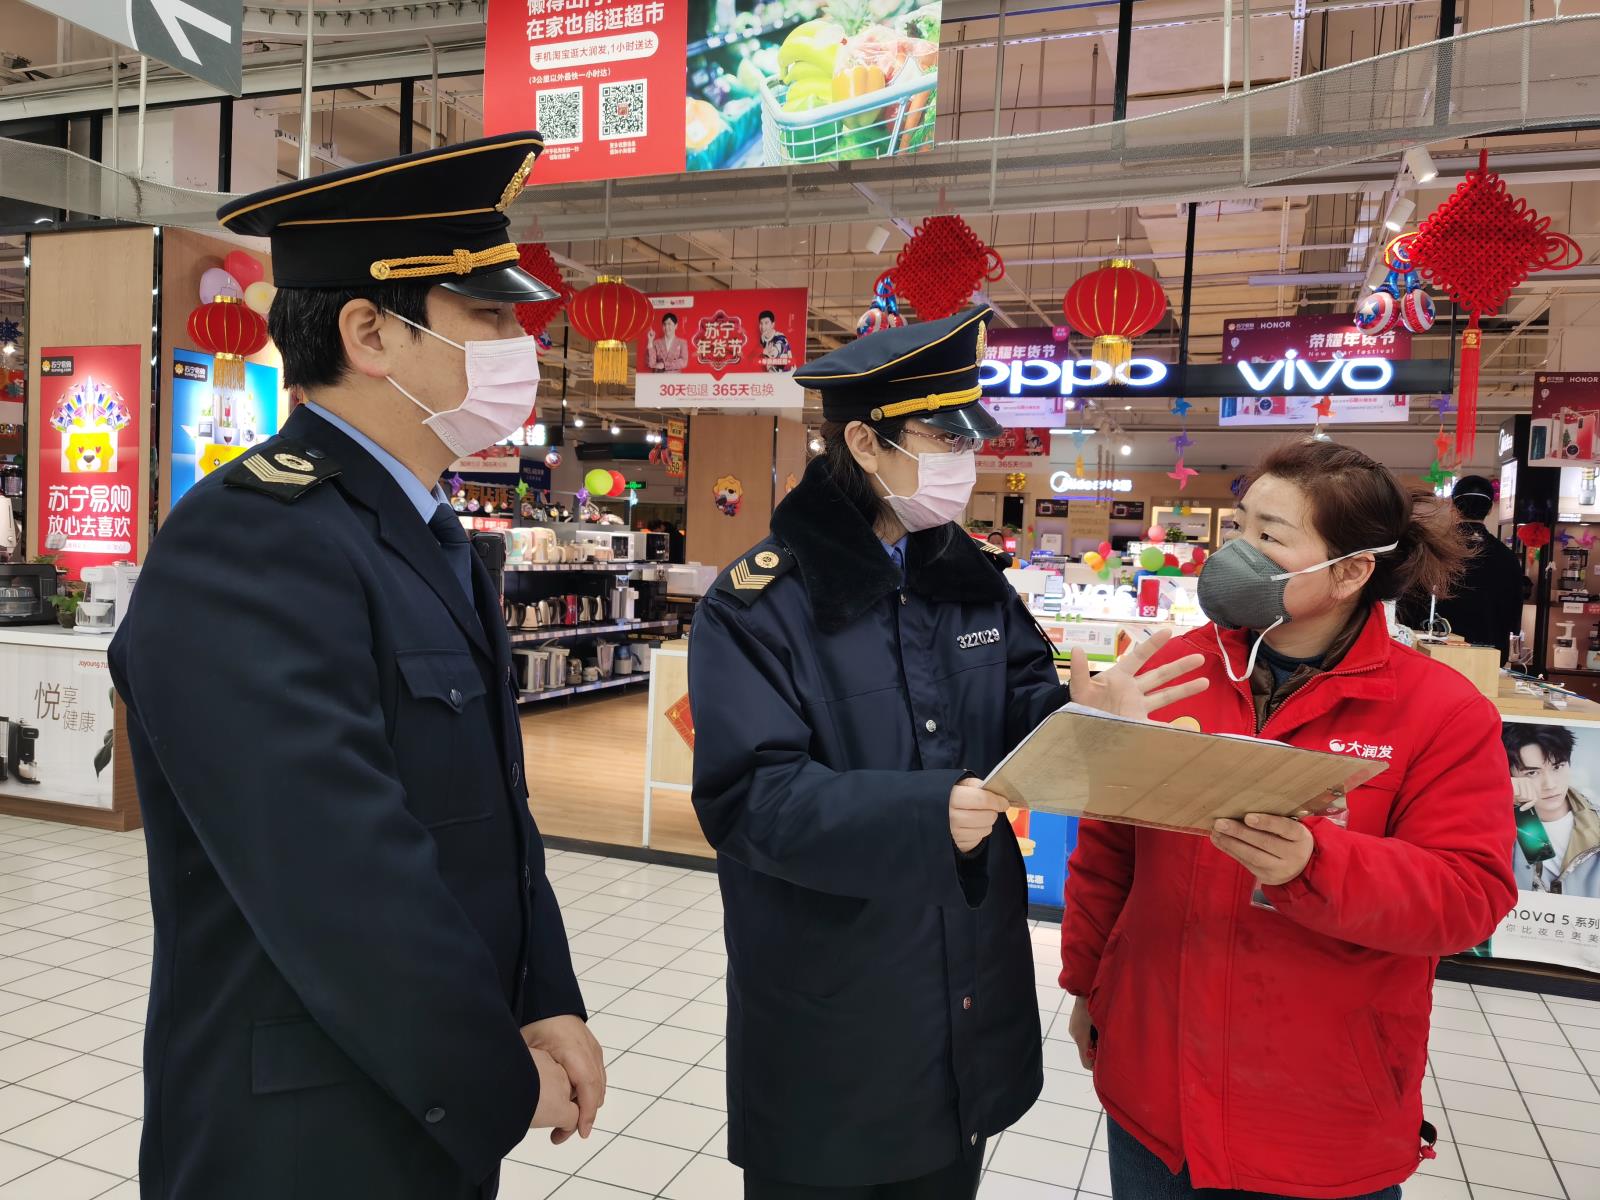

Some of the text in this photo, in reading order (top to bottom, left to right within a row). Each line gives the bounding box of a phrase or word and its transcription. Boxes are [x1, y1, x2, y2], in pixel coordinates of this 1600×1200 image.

[526, 2, 665, 41] 在家也能逛超市
[704, 322, 735, 339] 苏宁
[1260, 321, 1291, 329] HONOR
[696, 339, 743, 357] 年货节
[1308, 331, 1396, 349] 荣耀年货节
[978, 358, 1167, 394] oppo
[1237, 349, 1393, 391] vivo
[659, 383, 774, 397] 30天包退 365天包换
[48, 485, 131, 512] 苏宁易购
[47, 514, 131, 538] 放心去喜欢
[956, 628, 1000, 649] 322029
[62, 710, 97, 733] 健康
[1346, 740, 1393, 759] 大润发
[1506, 908, 1600, 930] nova 5 系列
